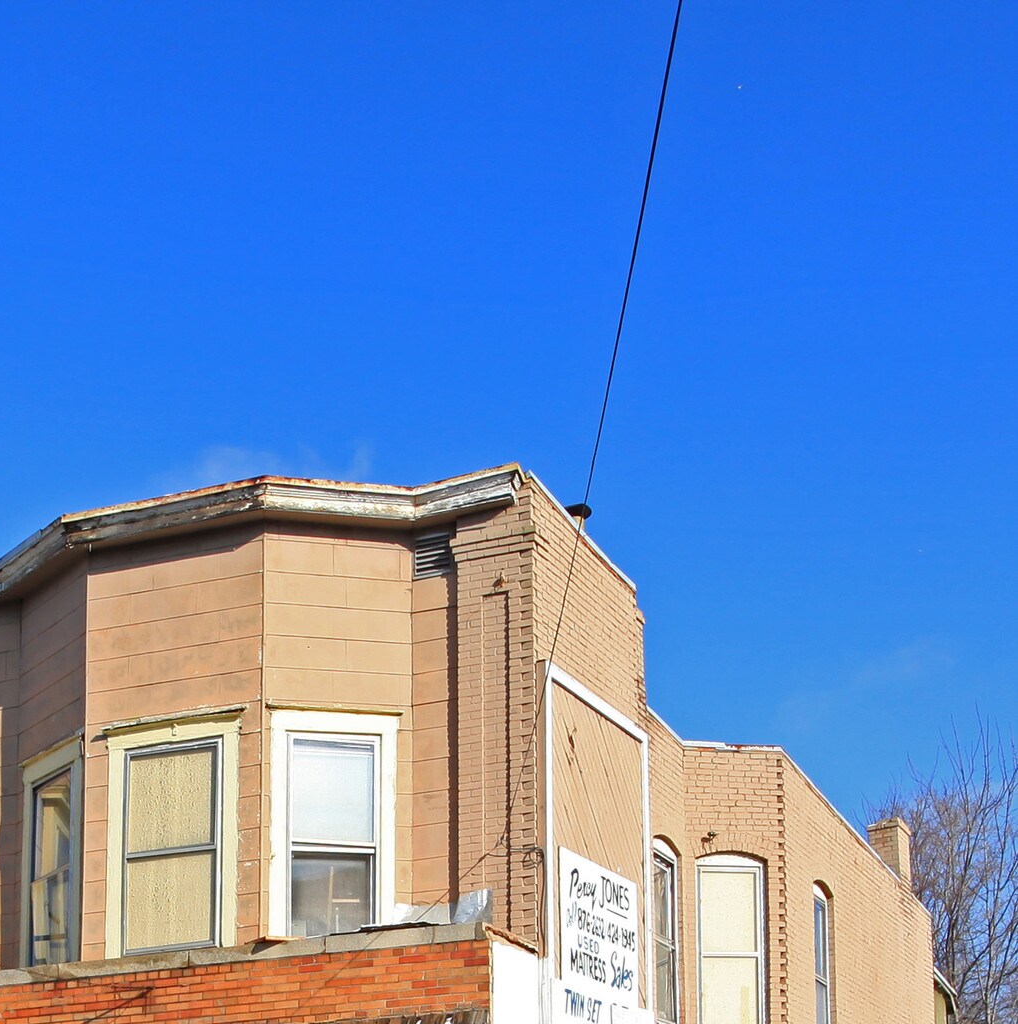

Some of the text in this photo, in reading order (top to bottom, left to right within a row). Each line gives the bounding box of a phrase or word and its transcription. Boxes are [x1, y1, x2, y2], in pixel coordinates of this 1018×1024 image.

[570, 868, 630, 913] Percy JONES
[578, 934, 600, 954] USED
[570, 948, 633, 990] MATTRESS Sales
[564, 988, 602, 1024] TWIN SET
